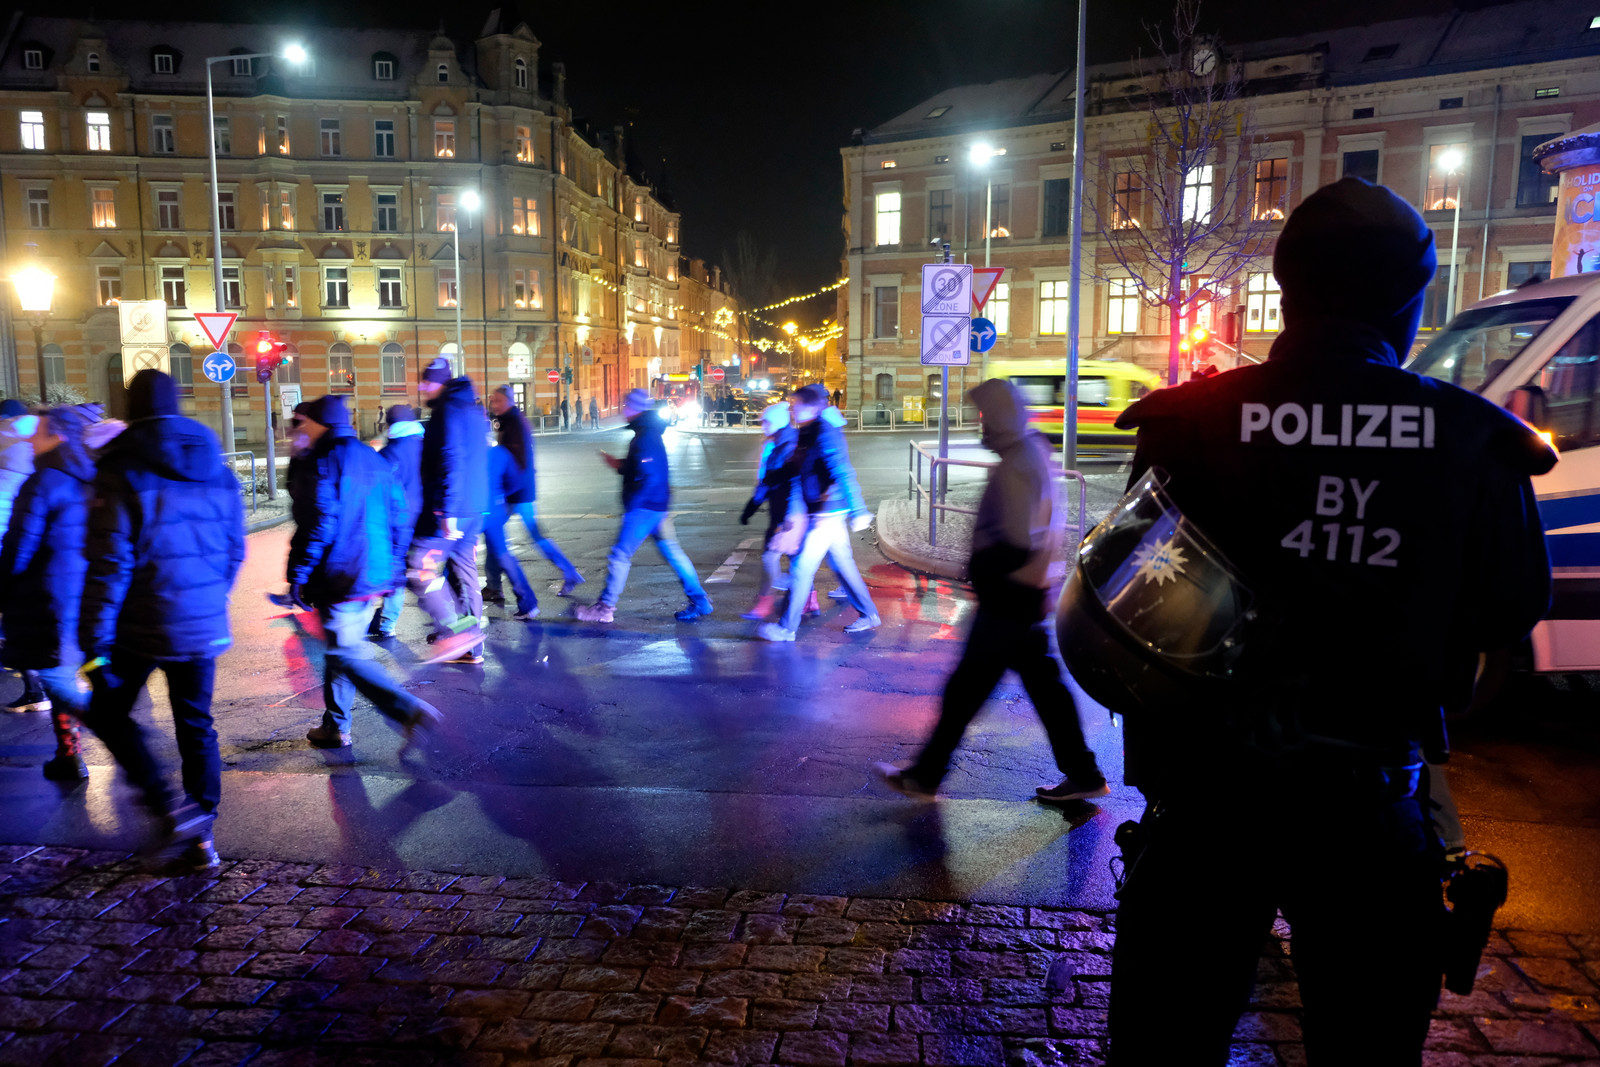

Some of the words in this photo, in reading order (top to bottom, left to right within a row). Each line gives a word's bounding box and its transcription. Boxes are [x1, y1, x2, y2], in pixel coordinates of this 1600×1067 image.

[934, 302, 958, 311] ZONE
[937, 277, 956, 292] 30
[1241, 402, 1435, 448] POLIZEI
[1316, 475, 1380, 519] BY
[1280, 519, 1401, 567] 4112
